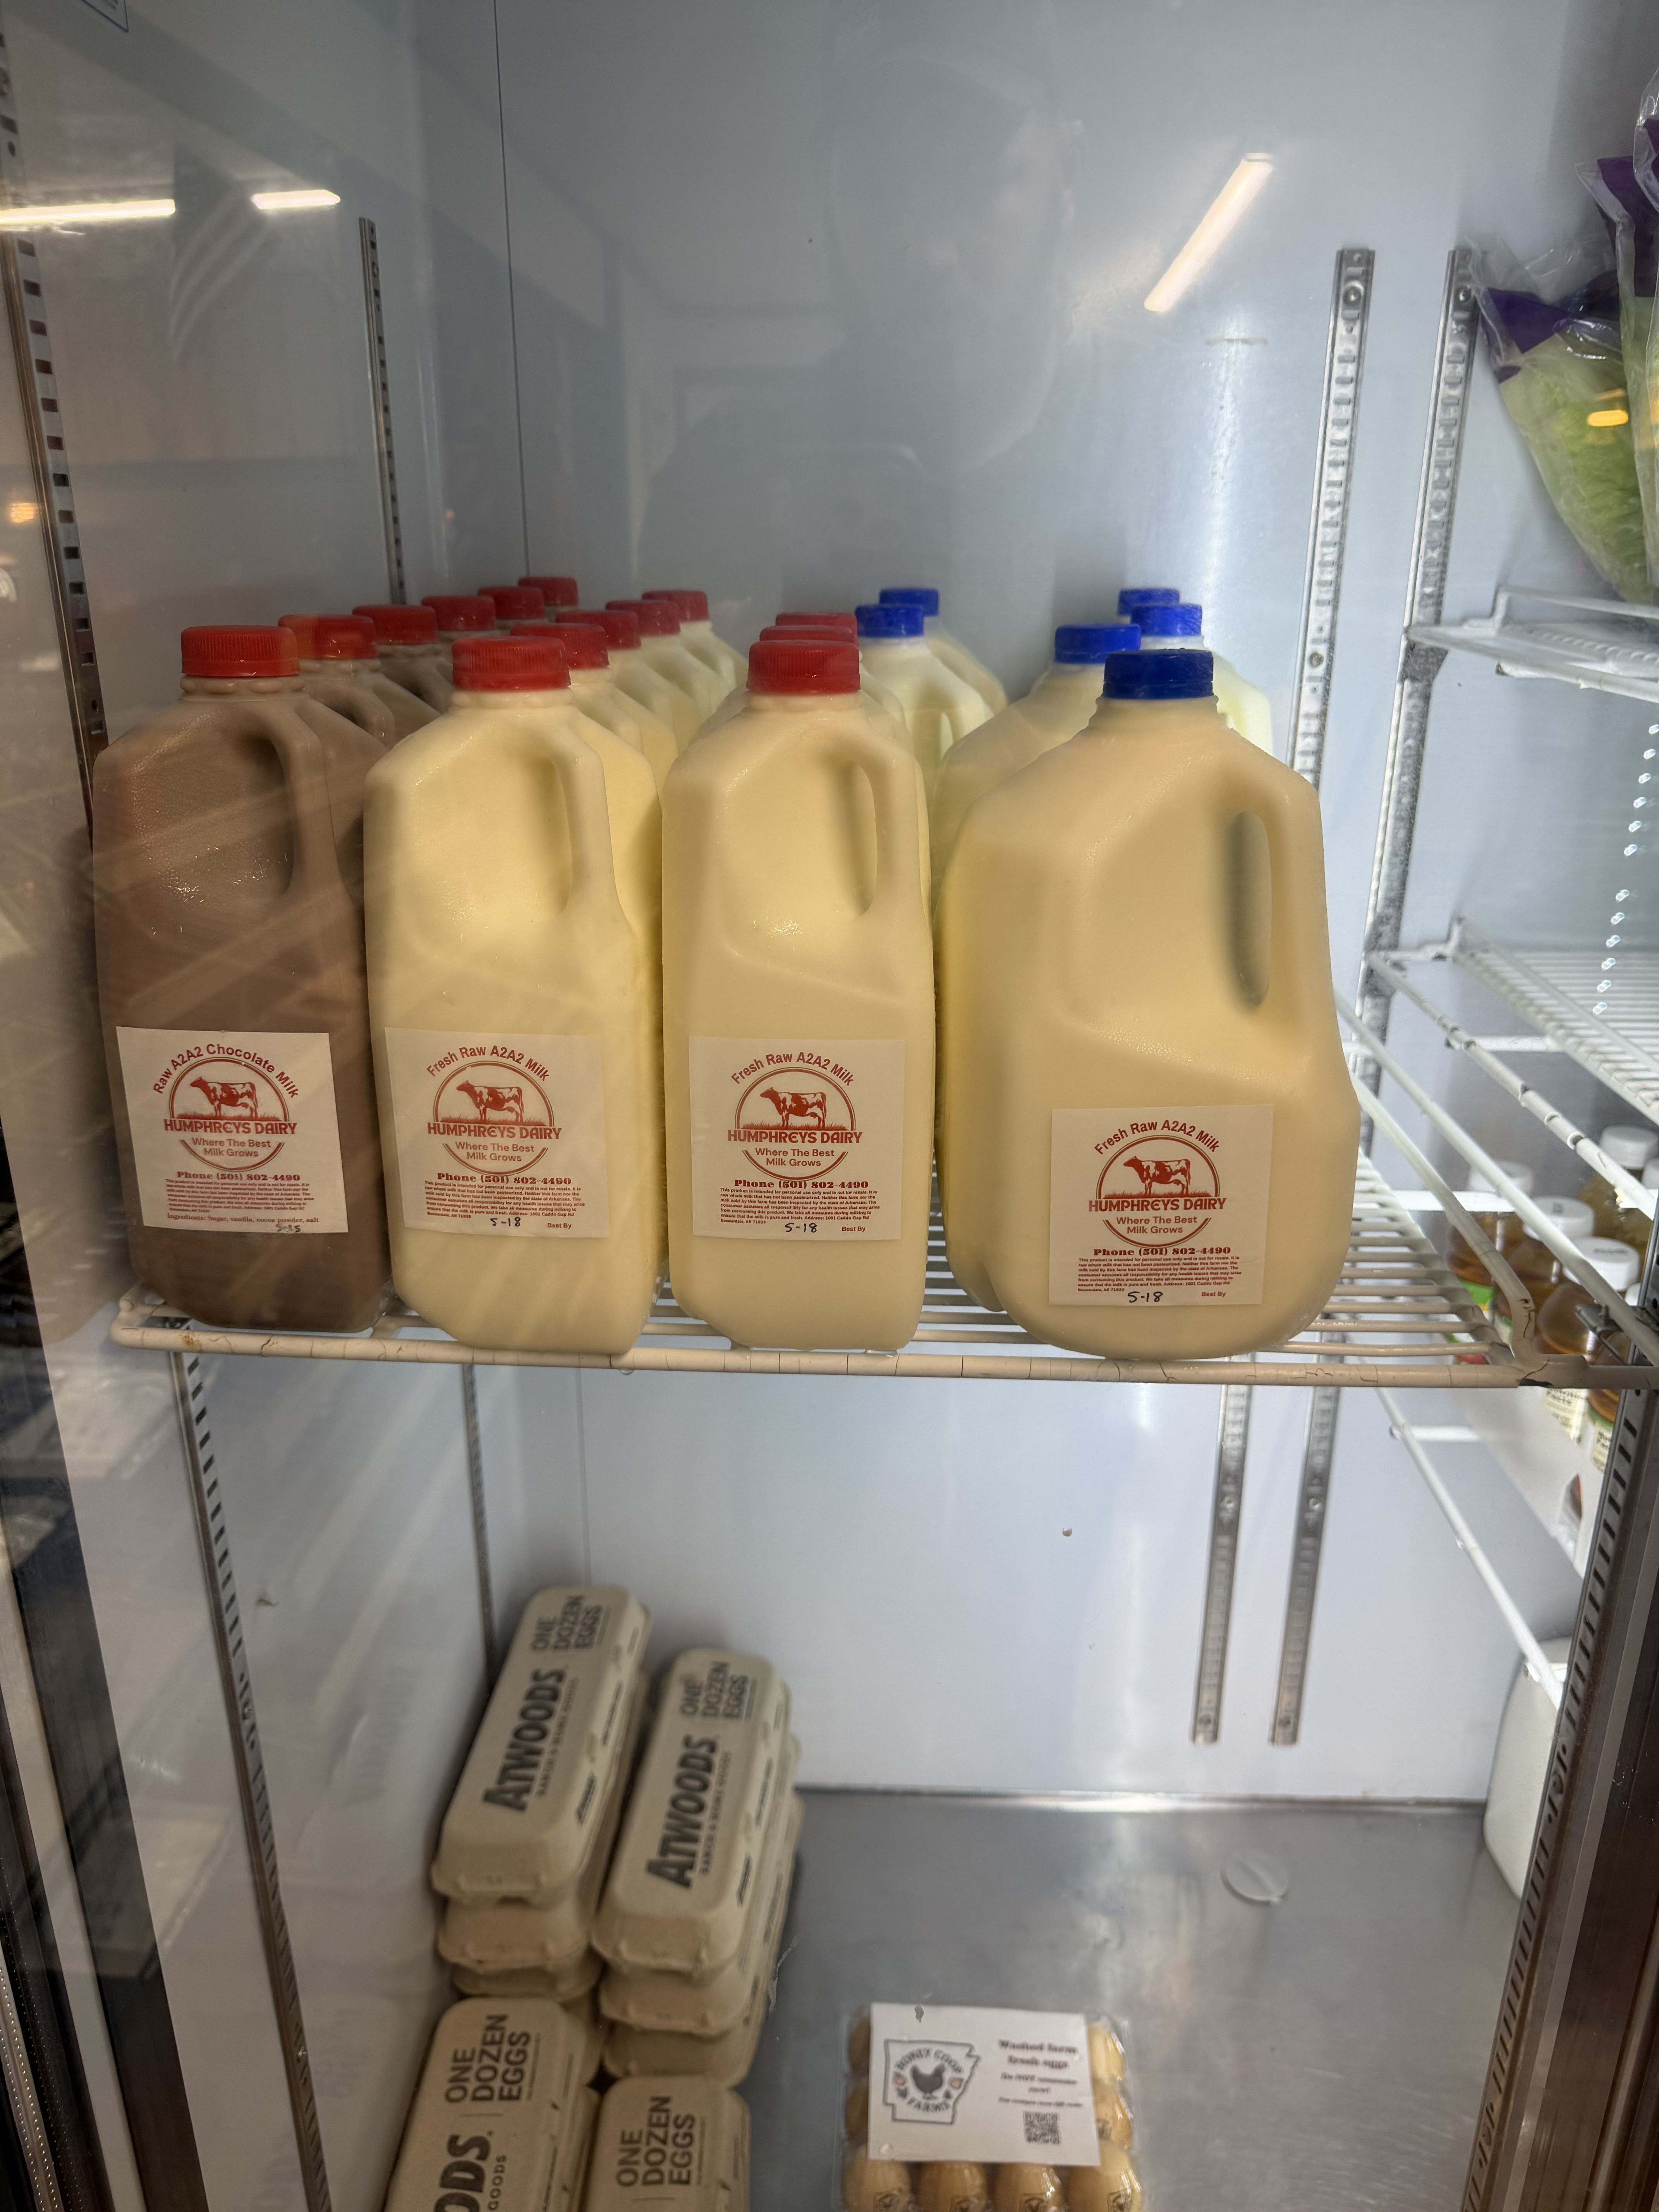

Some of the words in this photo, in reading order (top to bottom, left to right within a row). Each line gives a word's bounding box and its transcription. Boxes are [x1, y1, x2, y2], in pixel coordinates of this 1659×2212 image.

[153, 1068, 173, 1094] Raw
[170, 1046, 204, 1071] A2A2
[206, 1043, 275, 1073] Chocolate
[275, 1071, 299, 1099] Milk
[426, 1051, 459, 1077] Fresh
[459, 1047, 486, 1059] Raw
[490, 1045, 524, 1065] A2A2
[525, 1058, 550, 1082] Milk
[731, 1059, 764, 1084] Fresh
[765, 1053, 793, 1066] Raw
[796, 1051, 831, 1070] A2A2
[830, 1063, 854, 1087] Milk
[163, 1119, 252, 1134] HUMPHREYS
[254, 1122, 298, 1135] DAIRY
[427, 1122, 516, 1139] HUMPHREYS
[519, 1127, 562, 1140] DAIRY
[191, 1137, 225, 1147] Where
[226, 1139, 246, 1147] The
[248, 1139, 271, 1147] Best
[728, 1129, 817, 1144] HUMPHREYS
[820, 1131, 863, 1144] DAIRY
[1094, 1128, 1128, 1155] Fresh
[1130, 1121, 1158, 1135] Raw
[1161, 1119, 1196, 1137] A2A2
[1195, 1130, 1219, 1152] Milk
[204, 1147, 224, 1156] Milk
[226, 1148, 259, 1157] Grows
[455, 1141, 488, 1151] Where
[490, 1143, 510, 1152] The
[512, 1144, 535, 1152] Best
[755, 1147, 788, 1156] Where
[790, 1148, 810, 1157] The
[812, 1149, 835, 1157] Best
[467, 1152, 487, 1160] Milk
[489, 1152, 522, 1162] Grows
[766, 1158, 787, 1166] Milk
[789, 1158, 821, 1166] Grows
[177, 1171, 213, 1180] Phone
[437, 1173, 477, 1182] Phone
[480, 1174, 510, 1185] (501)
[513, 1176, 572, 1185] 802-4490
[734, 1179, 775, 1188] Phone
[778, 1180, 808, 1190] (501)
[811, 1181, 869, 1189] 802-4490
[1089, 1199, 1180, 1212] HUMPHREYS
[1183, 1197, 1227, 1211] DAIRY
[276, 1217, 305, 1225] powder,
[490, 1216, 521, 1227] 5-18
[785, 1222, 817, 1233] 5-18
[1116, 1216, 1150, 1224] Where
[1152, 1216, 1172, 1224] The
[1174, 1216, 1197, 1224] Best
[1127, 1226, 1148, 1234] Milk
[1150, 1226, 1183, 1234] Grows
[1138, 1247, 1168, 1257] (501)
[1171, 1247, 1231, 1255] 802-4490
[1127, 1291, 1163, 1303] 5-18
[553, 1595, 584, 1650] DOZEN
[575, 1605, 603, 1649] EGGS
[531, 1617, 555, 1651] ONE
[702, 1661, 730, 1717] DOZEN
[723, 1674, 748, 1719] EGGS
[482, 1668, 566, 1813] ATWOODS
[646, 1734, 719, 1890] ATWOODS
[470, 2014, 509, 2102] DOZEN
[498, 2031, 530, 2101] EGGS
[445, 2047, 477, 2103] ONE
[641, 2096, 672, 2186] DOZEN
[616, 2130, 642, 2186] ONE
[668, 2114, 695, 2186] EGGS
[488, 2155, 507, 2211] GOODS
